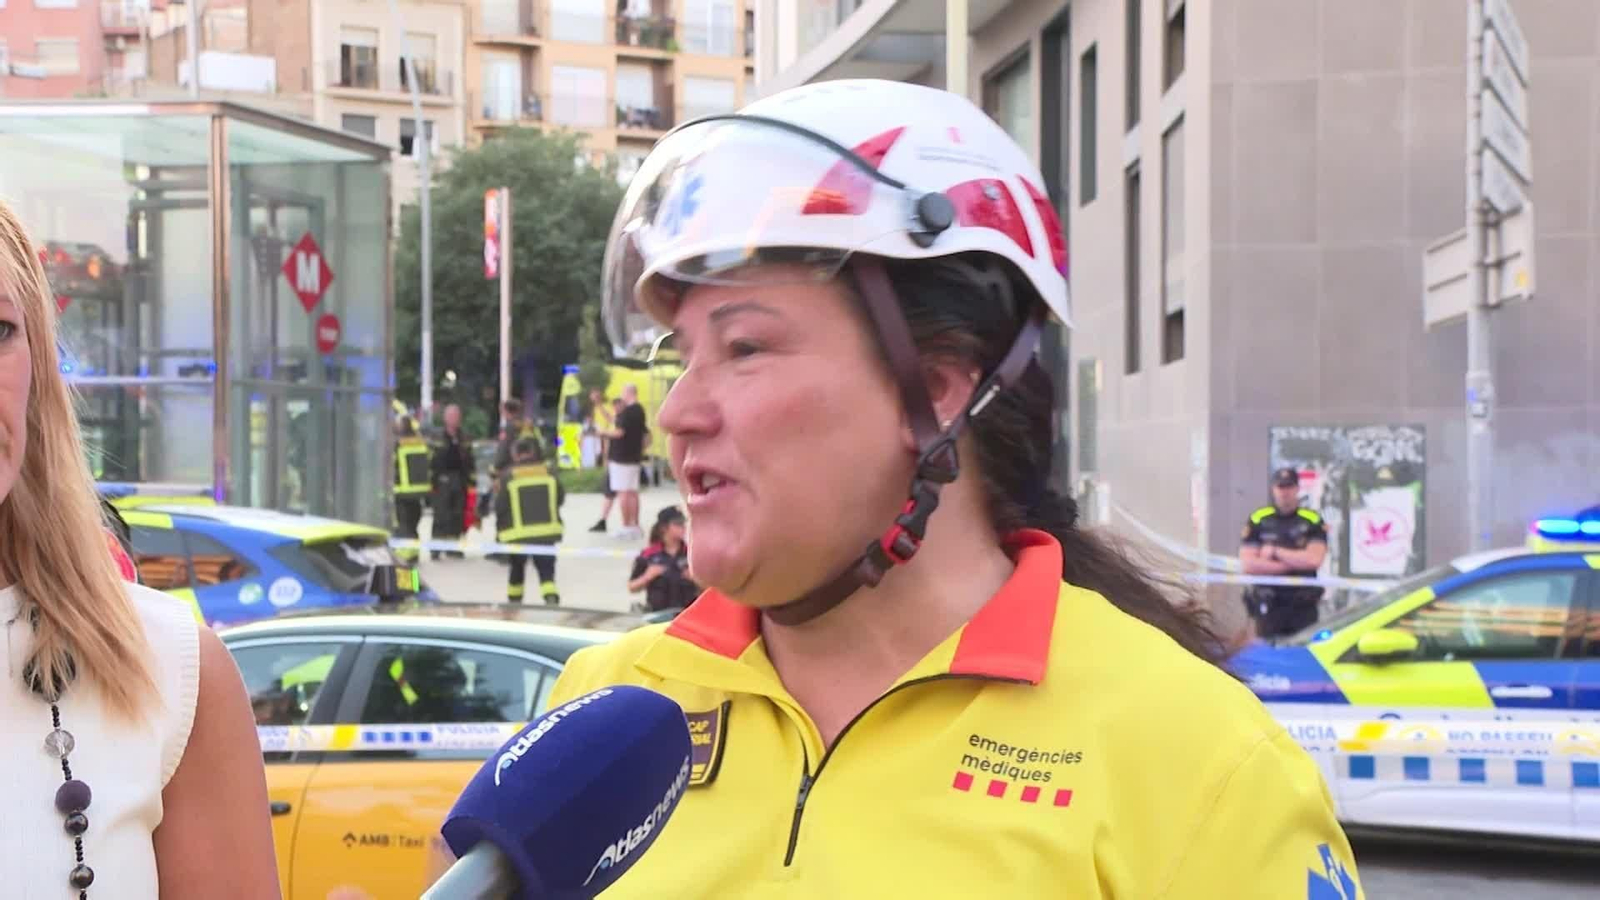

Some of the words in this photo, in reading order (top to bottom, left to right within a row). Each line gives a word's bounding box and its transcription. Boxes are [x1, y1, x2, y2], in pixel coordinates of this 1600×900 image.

[297, 252, 320, 294] M
[360, 833, 390, 847] AMB
[399, 834, 425, 848] Taxi
